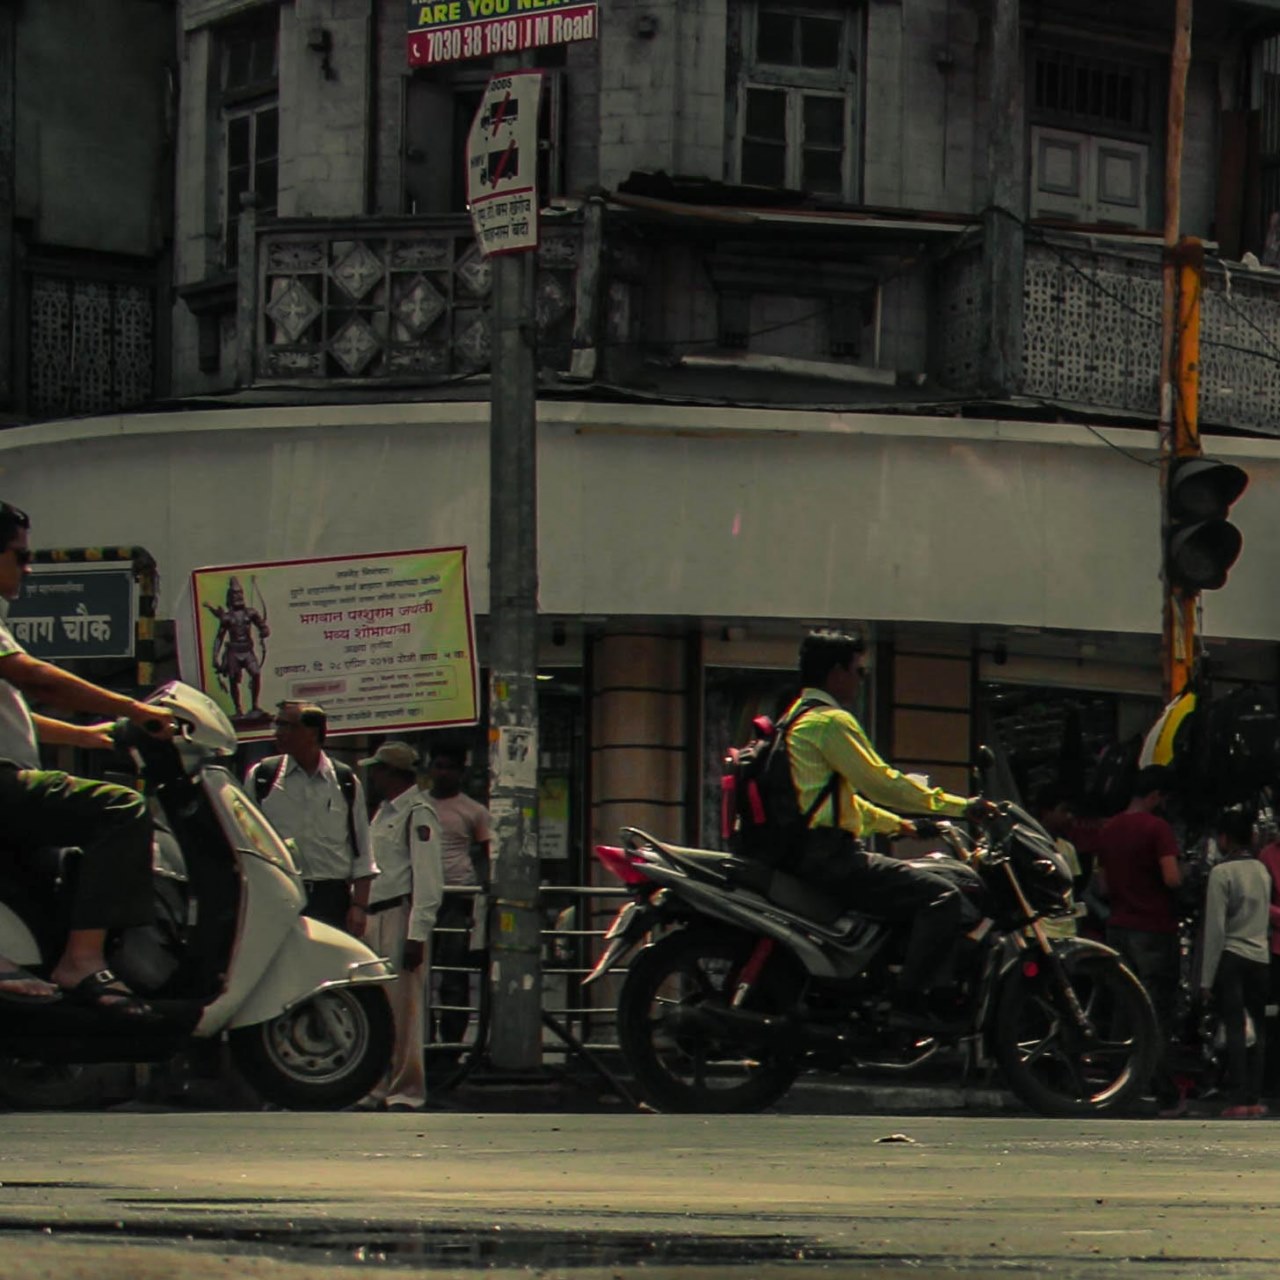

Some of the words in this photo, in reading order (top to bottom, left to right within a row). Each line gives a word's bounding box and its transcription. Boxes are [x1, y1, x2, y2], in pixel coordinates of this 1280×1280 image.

[419, 3, 460, 25] ARE
[467, 0, 509, 17] YOU
[427, 29, 461, 62] 7030
[464, 26, 483, 56] 38
[485, 20, 517, 54] 1919
[524, 19, 532, 48] J
[535, 16, 549, 46] M
[552, 10, 593, 43] Road
[60, 602, 112, 643] चौक
